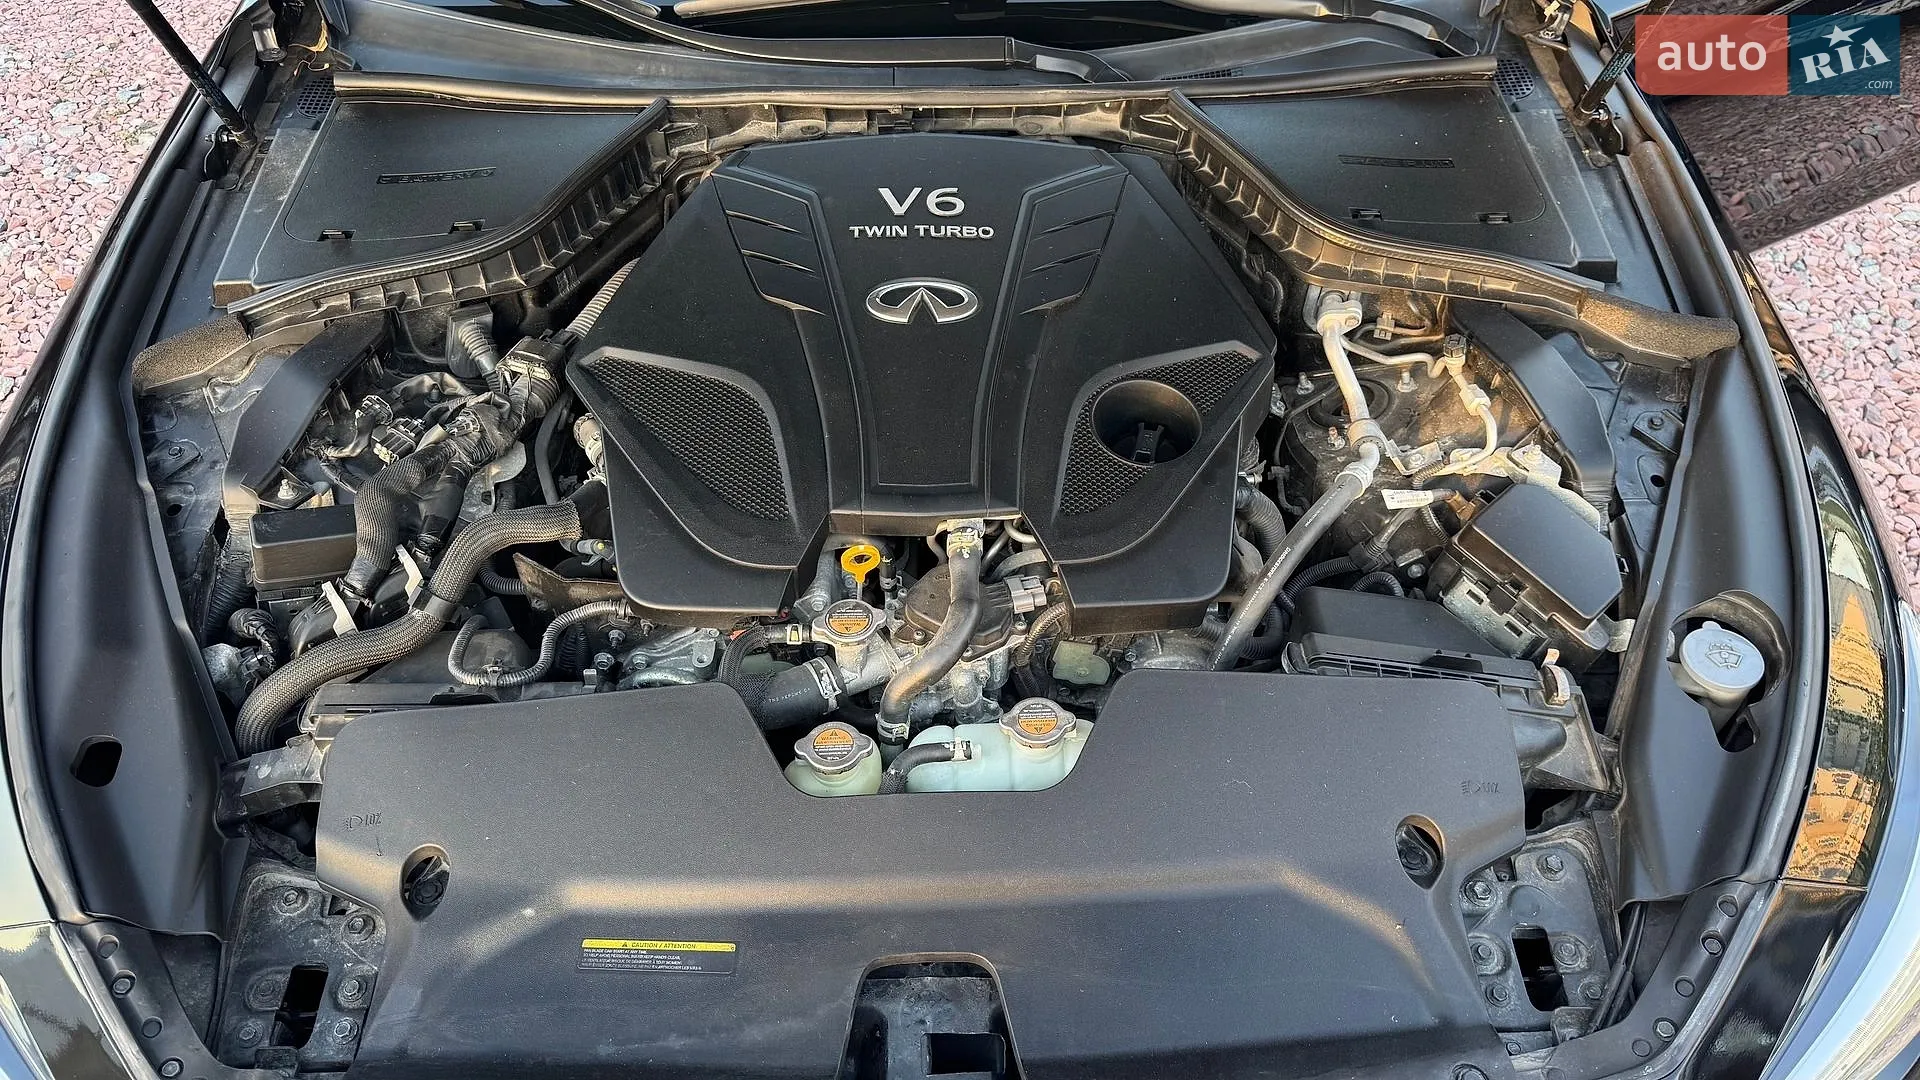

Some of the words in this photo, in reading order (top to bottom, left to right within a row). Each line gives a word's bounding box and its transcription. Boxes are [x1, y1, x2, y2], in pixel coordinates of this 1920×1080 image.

[878, 187, 965, 217] V6
[849, 225, 908, 239] TWIN
[914, 225, 995, 239] TURBO
